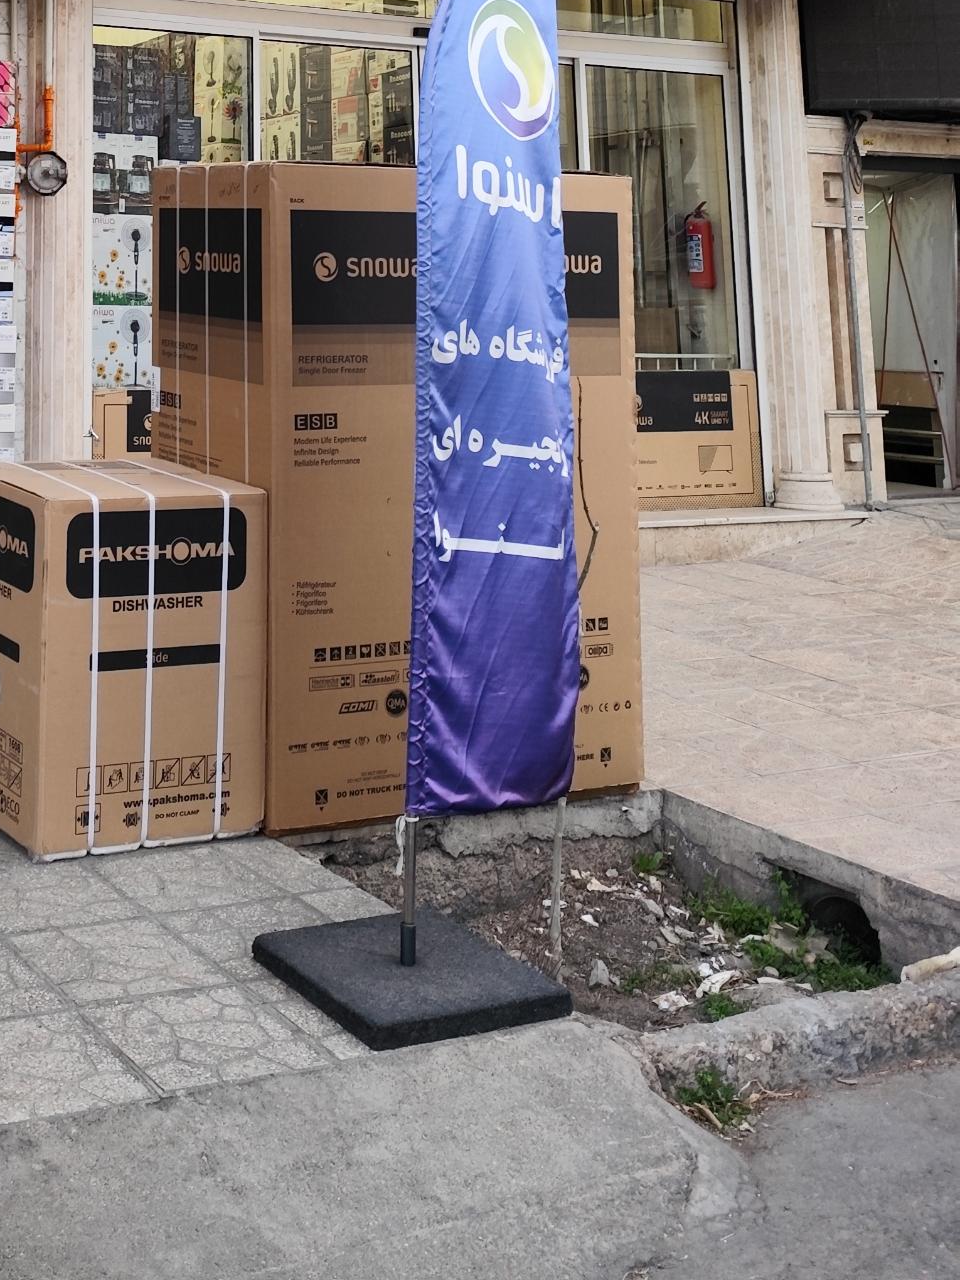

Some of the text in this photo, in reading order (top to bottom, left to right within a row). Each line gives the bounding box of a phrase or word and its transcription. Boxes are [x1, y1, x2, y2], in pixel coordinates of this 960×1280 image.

[194, 251, 241, 273] snowa
[92, 308, 115, 317] niwa
[432, 319, 481, 364] های
[298, 355, 369, 364] REFRIGERATOR
[298, 366, 320, 375] Single
[294, 414, 338, 431] ESB
[694, 410, 710, 425] 4K
[133, 434, 152, 446] sno
[293, 435, 367, 446] Modern Life Experience
[293, 447, 340, 457] Infinite Design
[293, 458, 361, 467] Reliable Performance
[146, 652, 169, 664] ide
[123, 789, 231, 808] www.pakshoma.cm
[336, 791, 347, 799] DO
[349, 789, 365, 797] NOT
[366, 786, 391, 796] TRUCK
[154, 808, 200, 820] DO NOT CLAMP
